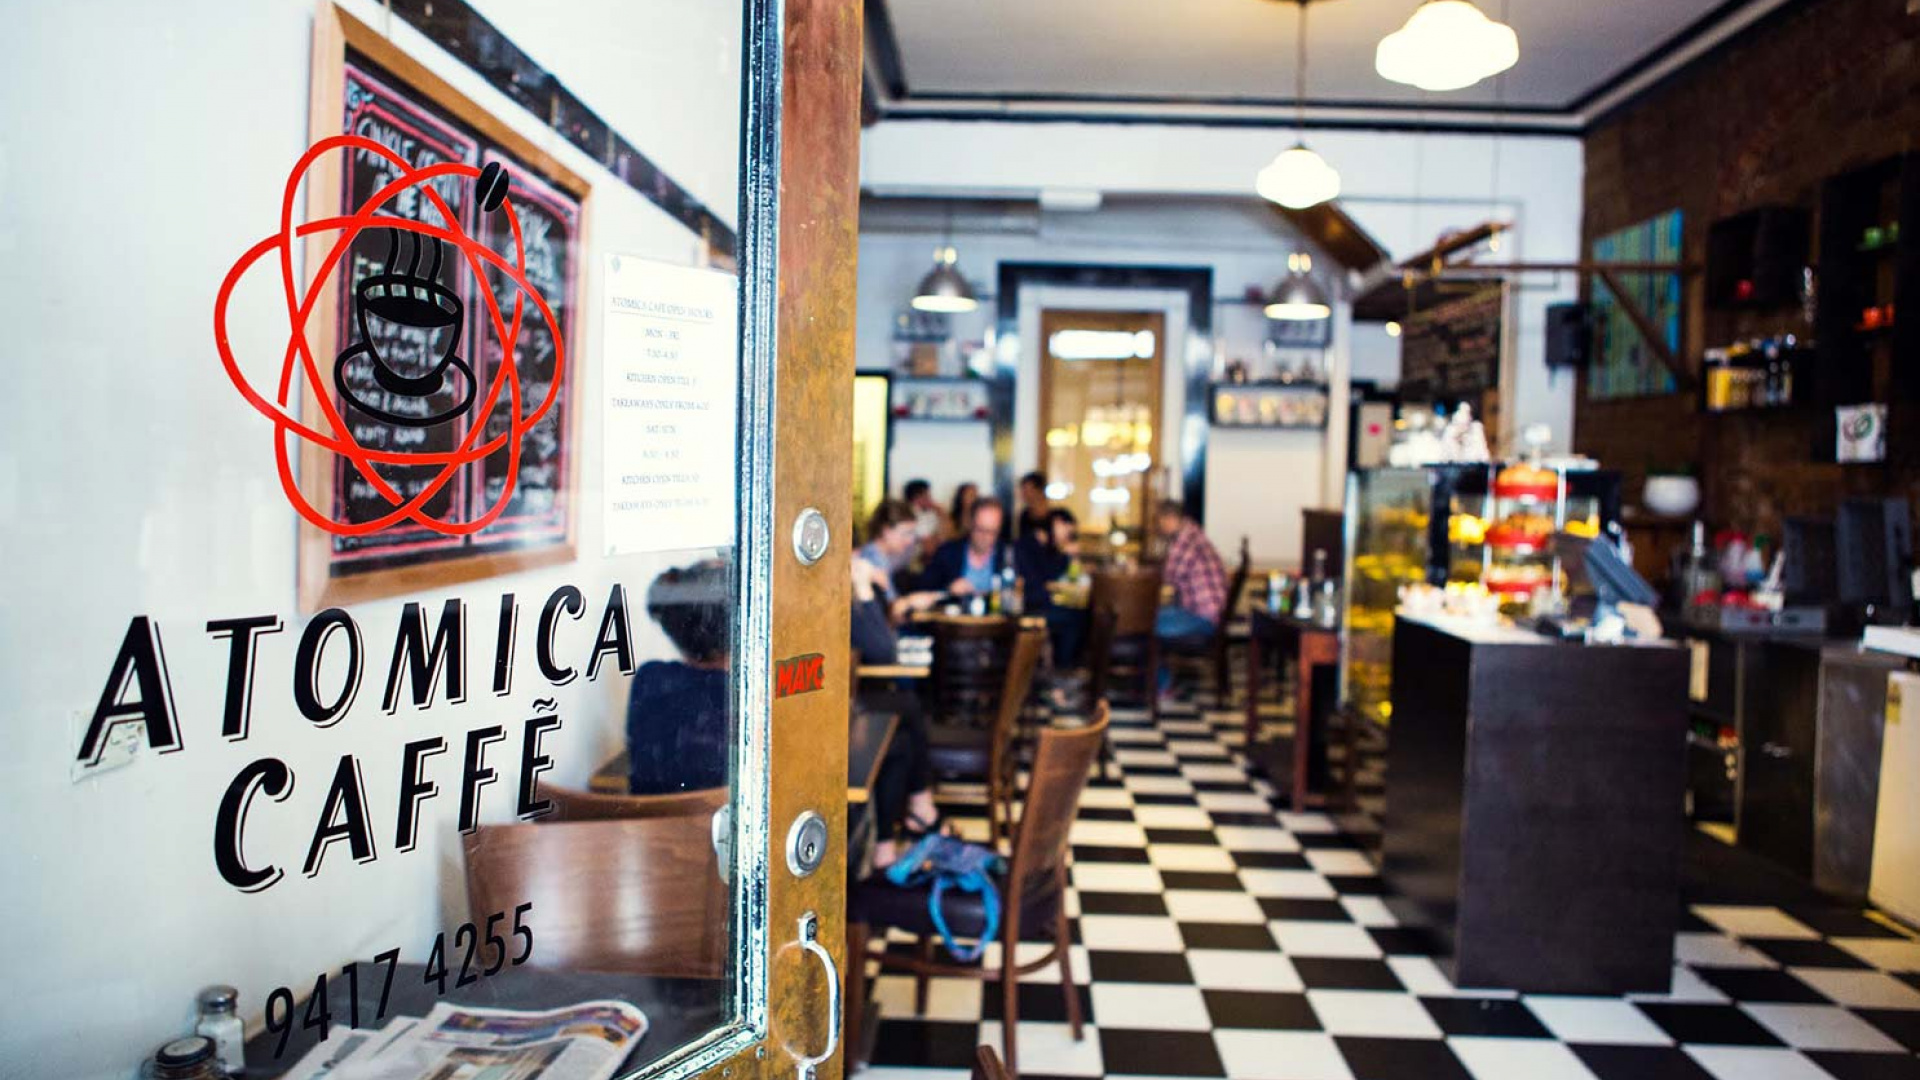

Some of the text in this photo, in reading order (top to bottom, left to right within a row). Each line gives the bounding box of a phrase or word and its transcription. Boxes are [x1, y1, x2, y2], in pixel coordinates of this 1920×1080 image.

[77, 583, 636, 767] ATOMICA
[265, 902, 533, 1059] 9417 4255
